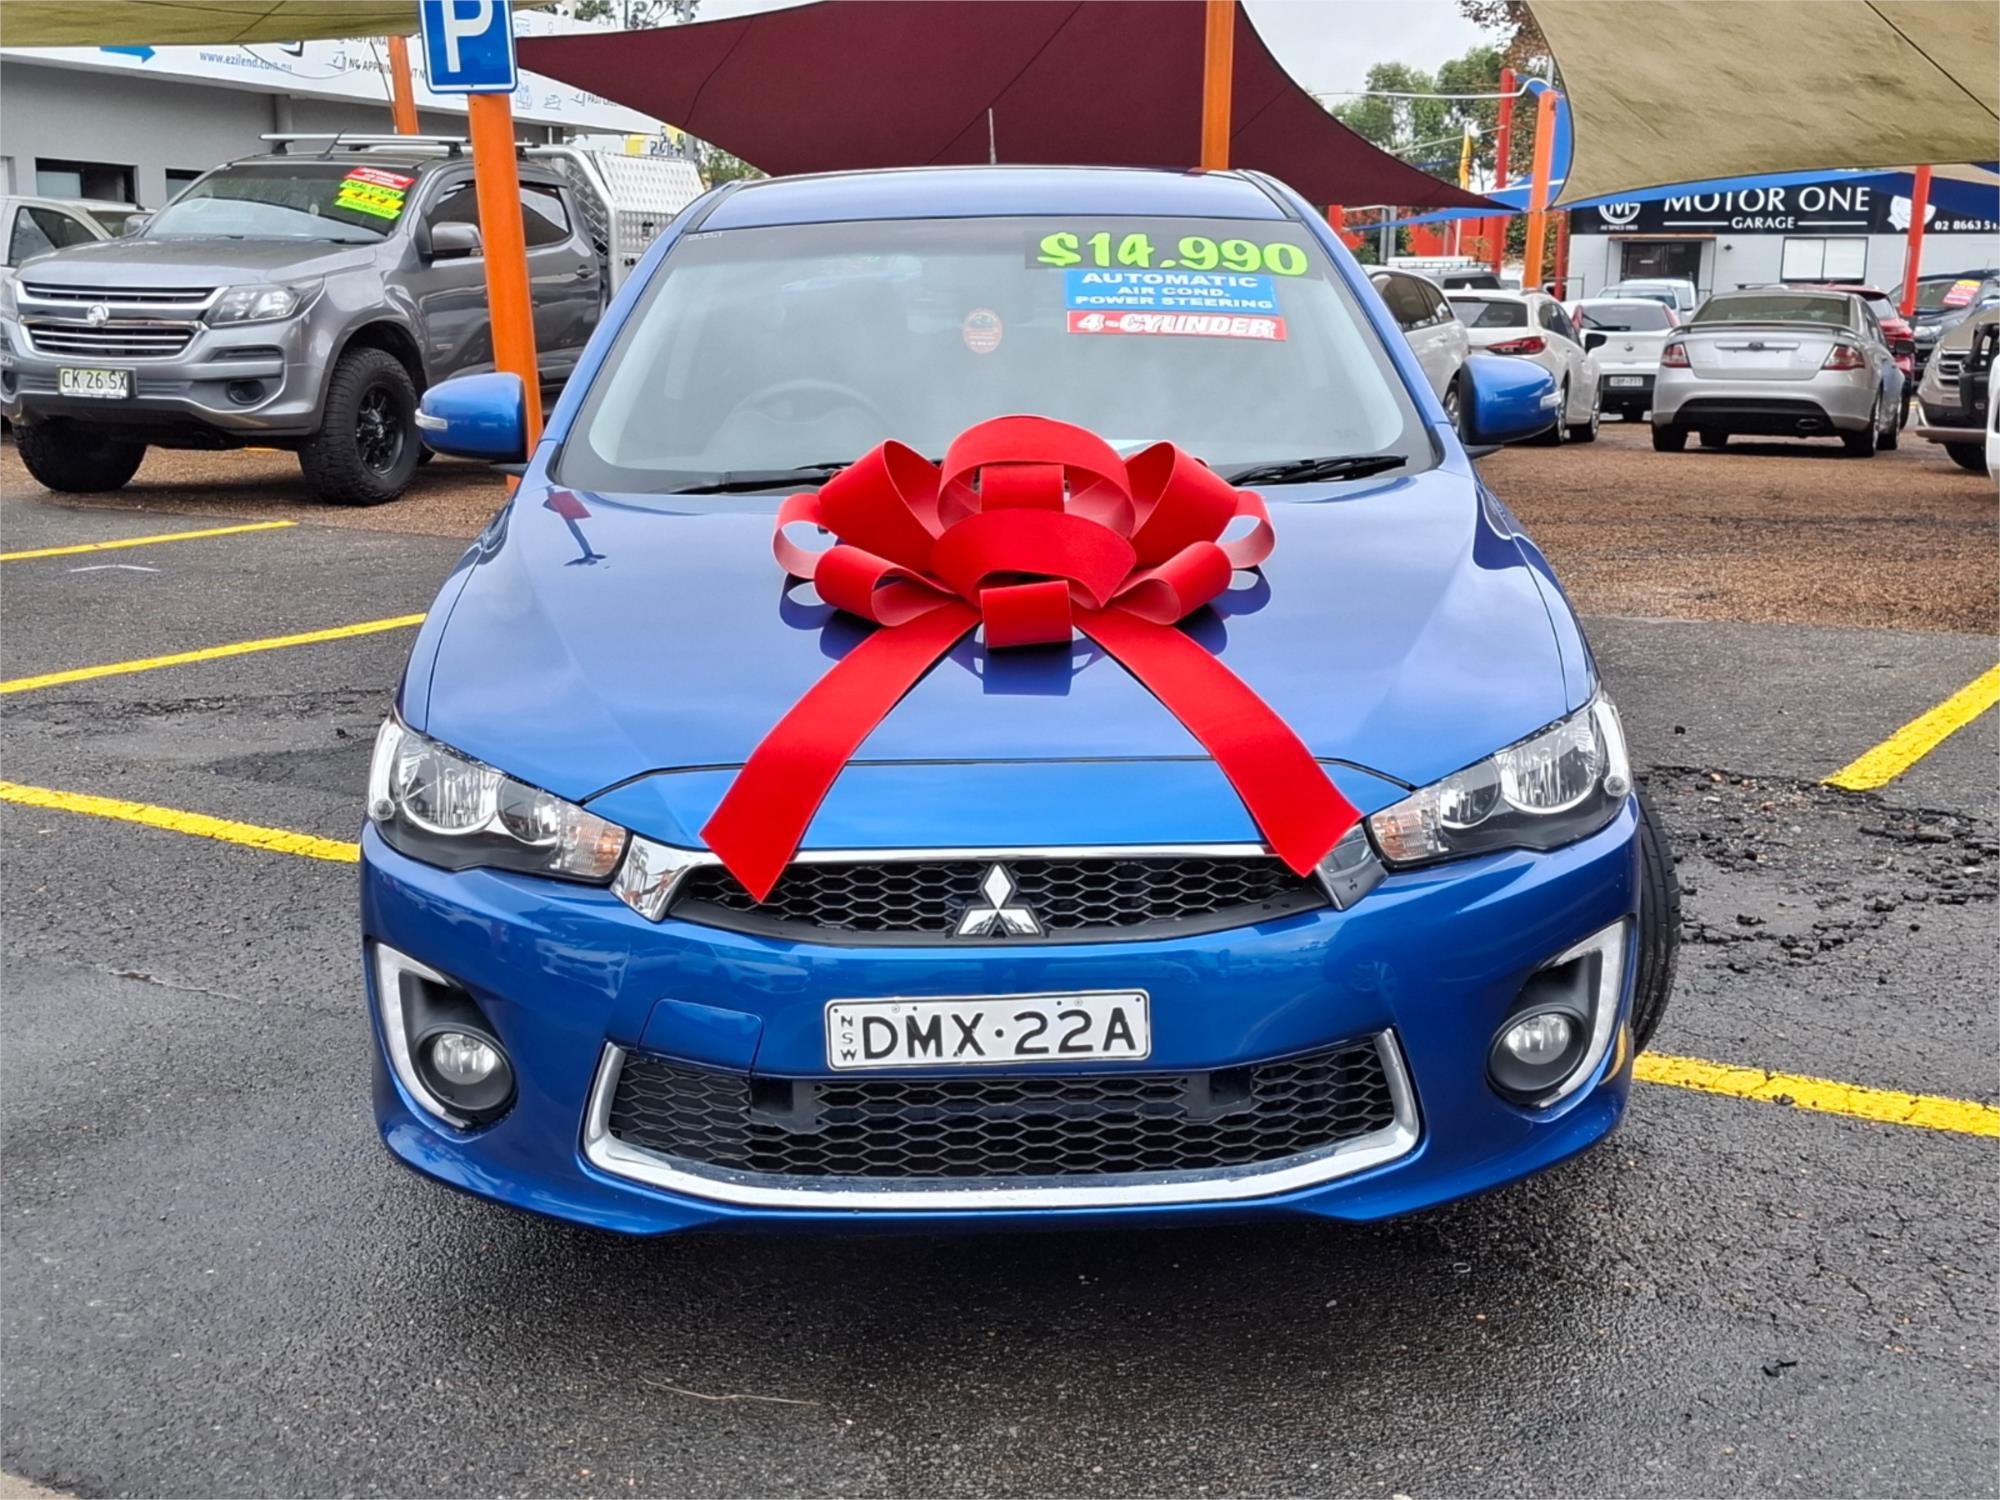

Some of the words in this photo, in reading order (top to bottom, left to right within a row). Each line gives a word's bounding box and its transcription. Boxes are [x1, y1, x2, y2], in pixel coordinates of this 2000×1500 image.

[441, 0, 493, 73] P
[1663, 187, 1786, 212] MOTOR
[1798, 187, 1870, 211] ONE
[1731, 216, 1795, 229] GARAGE
[1934, 220, 1949, 231] 02
[1952, 220, 1982, 231] 8663
[1081, 272, 1259, 288] AUTOMATIC
[1117, 286, 1156, 295] AIR
[1160, 287, 1231, 297] COND.
[1074, 295, 1155, 304] POWER
[1161, 297, 1274, 309] STEERING
[1076, 312, 1277, 340] 4-CYLINDER
[86, 371, 103, 389] 26
[839, 1015, 857, 1062] NSW
